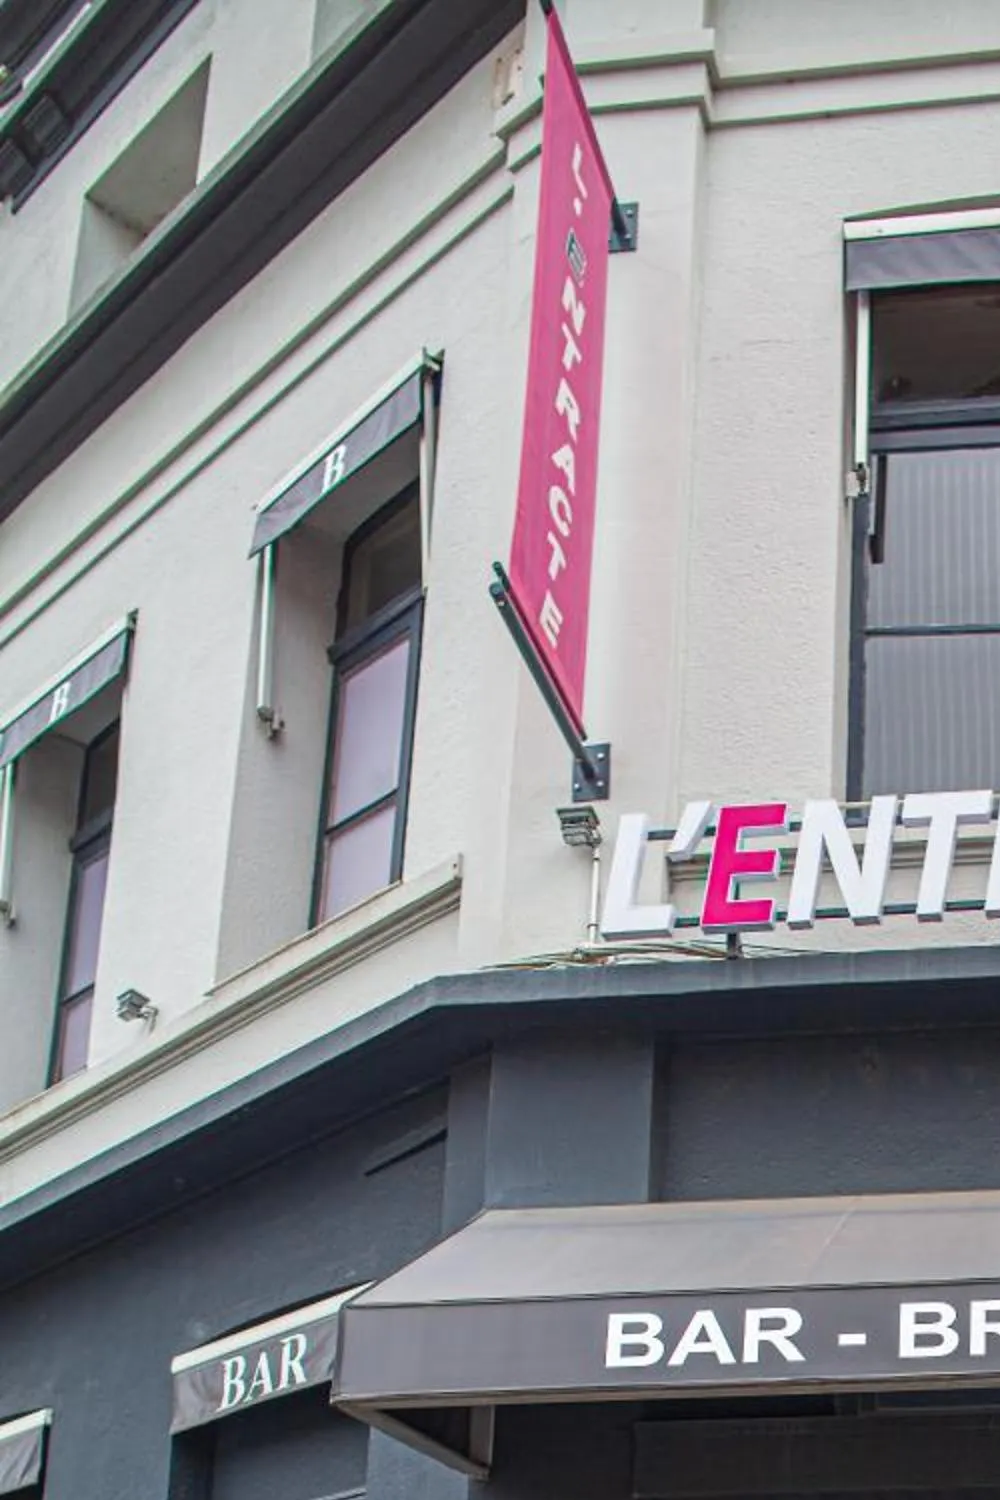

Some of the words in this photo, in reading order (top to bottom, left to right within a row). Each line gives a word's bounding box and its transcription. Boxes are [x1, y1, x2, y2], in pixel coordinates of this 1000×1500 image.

[320, 444, 346, 495] B
[48, 681, 71, 725] B
[604, 1307, 807, 1369] BAR
[215, 1333, 307, 1413] BAR
